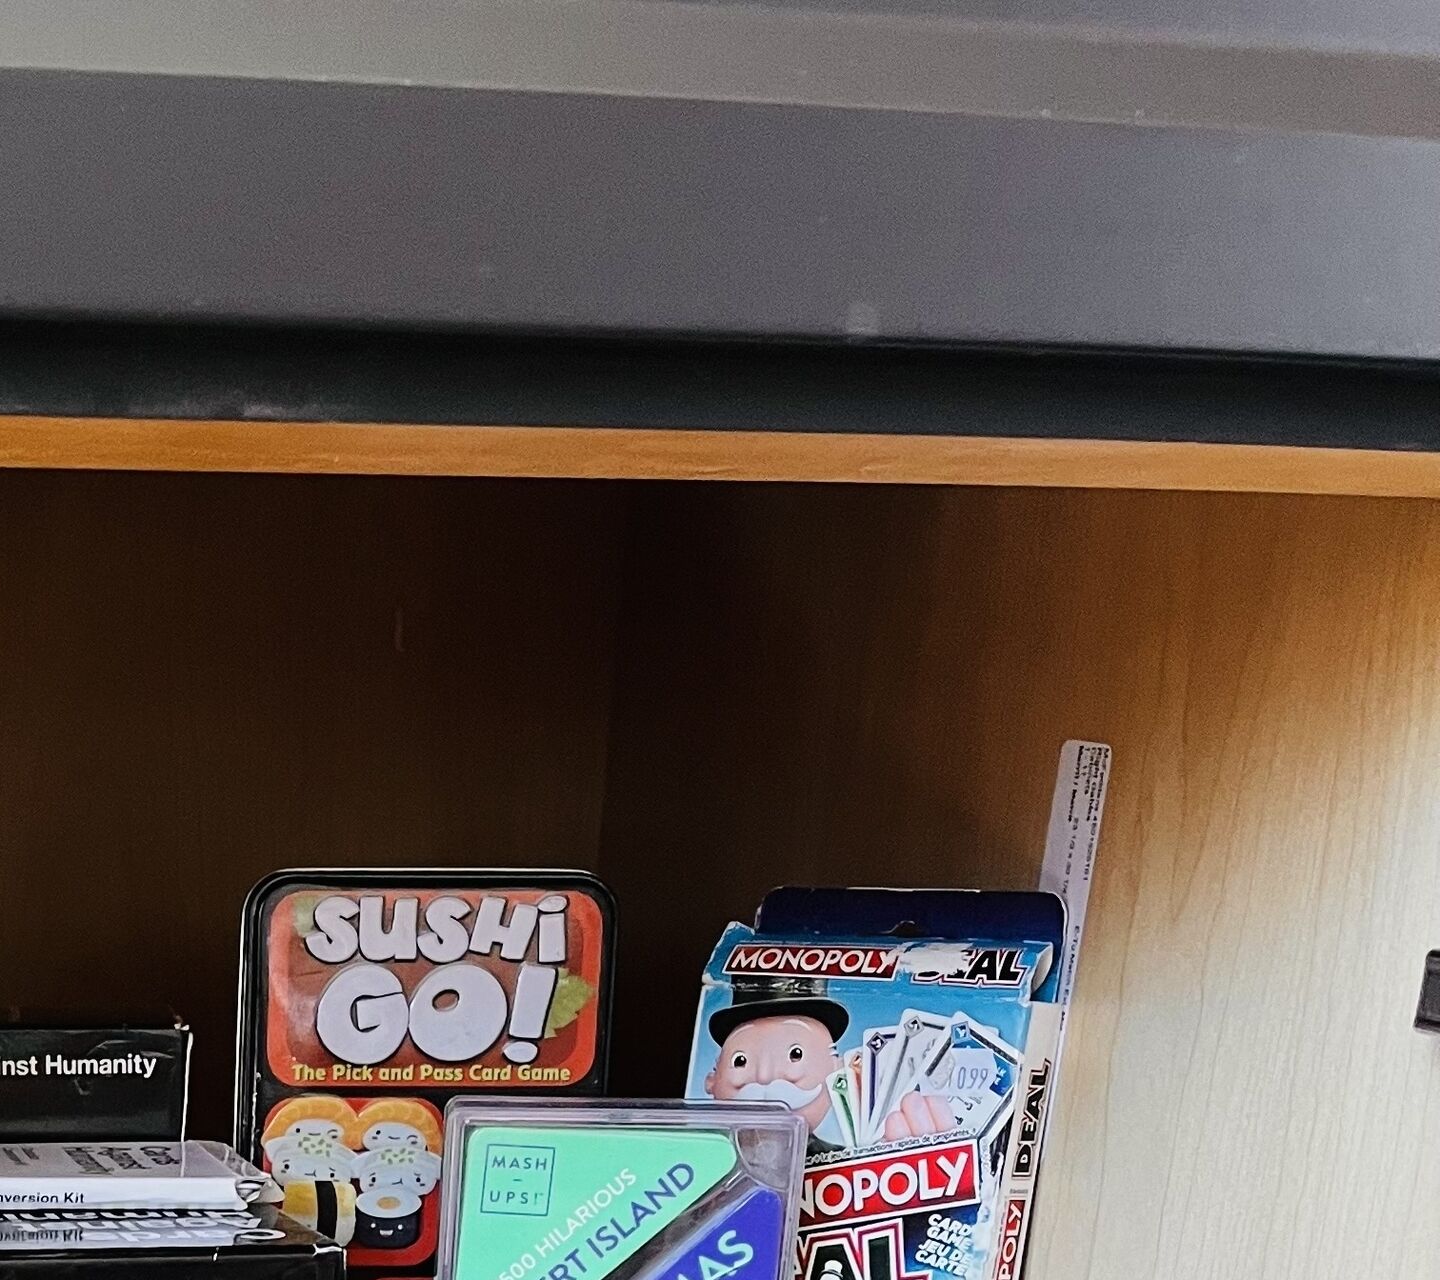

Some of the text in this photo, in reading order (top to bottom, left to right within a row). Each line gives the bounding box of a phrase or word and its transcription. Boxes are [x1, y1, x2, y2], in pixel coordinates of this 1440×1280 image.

[731, 949, 891, 974] MONOPOLY
[316, 963, 559, 1064] GO!
[45, 1054, 157, 1079] Humanity
[292, 1063, 570, 1082] The Pick and Pass Card Game
[1012, 1059, 1050, 1177] DEAL
[492, 1156, 548, 1171] MASH
[64, 1190, 85, 1204] Kit
[489, 1191, 539, 1205] UPS!
[536, 1168, 637, 1259] HILARIOUS
[586, 1162, 695, 1259] ISLAND
[928, 1213, 972, 1237] CARD
[926, 1227, 972, 1250] GAME
